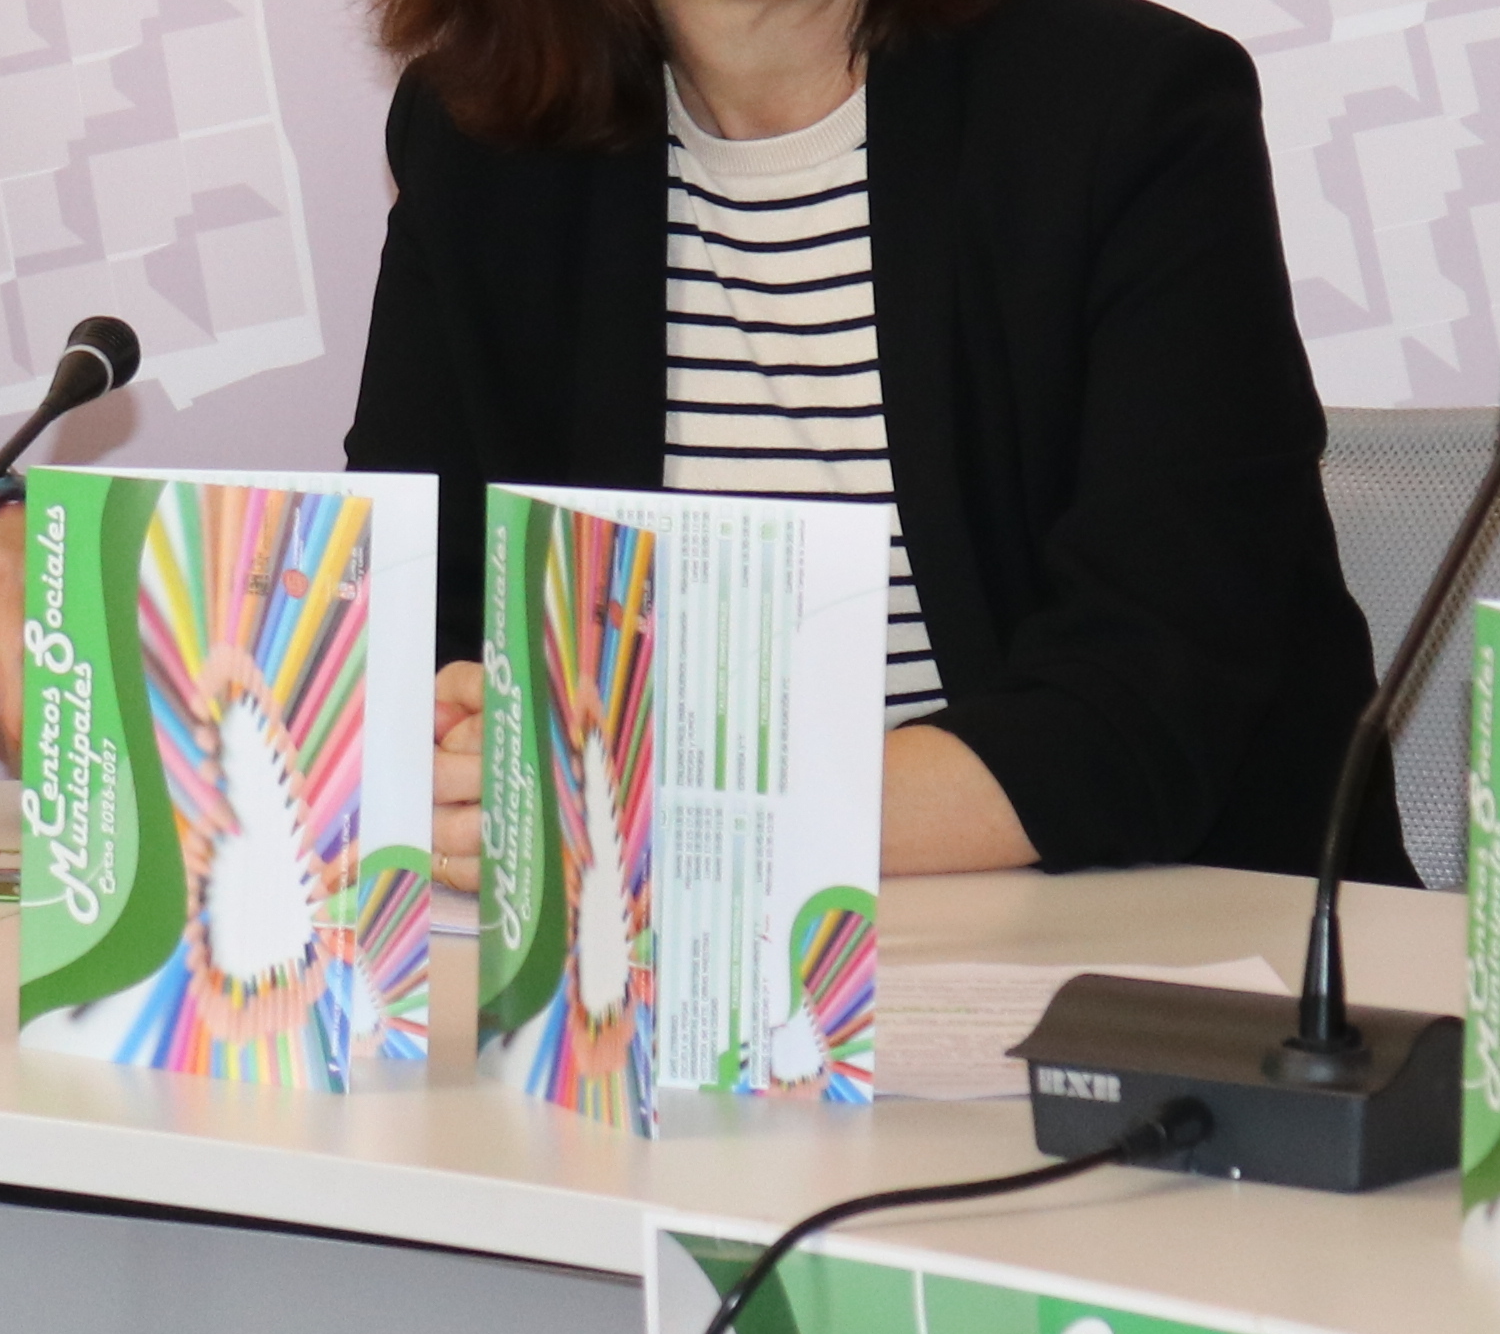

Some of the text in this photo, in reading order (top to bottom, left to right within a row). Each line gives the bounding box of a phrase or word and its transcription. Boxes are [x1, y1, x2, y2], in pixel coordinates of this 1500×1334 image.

[21, 505, 74, 839] Centros Sociales
[48, 663, 99, 925] Municipales
[481, 525, 511, 859] Centros Sociales
[495, 686, 526, 950] Municipales
[1466, 646, 1497, 1024] Centros Sociales
